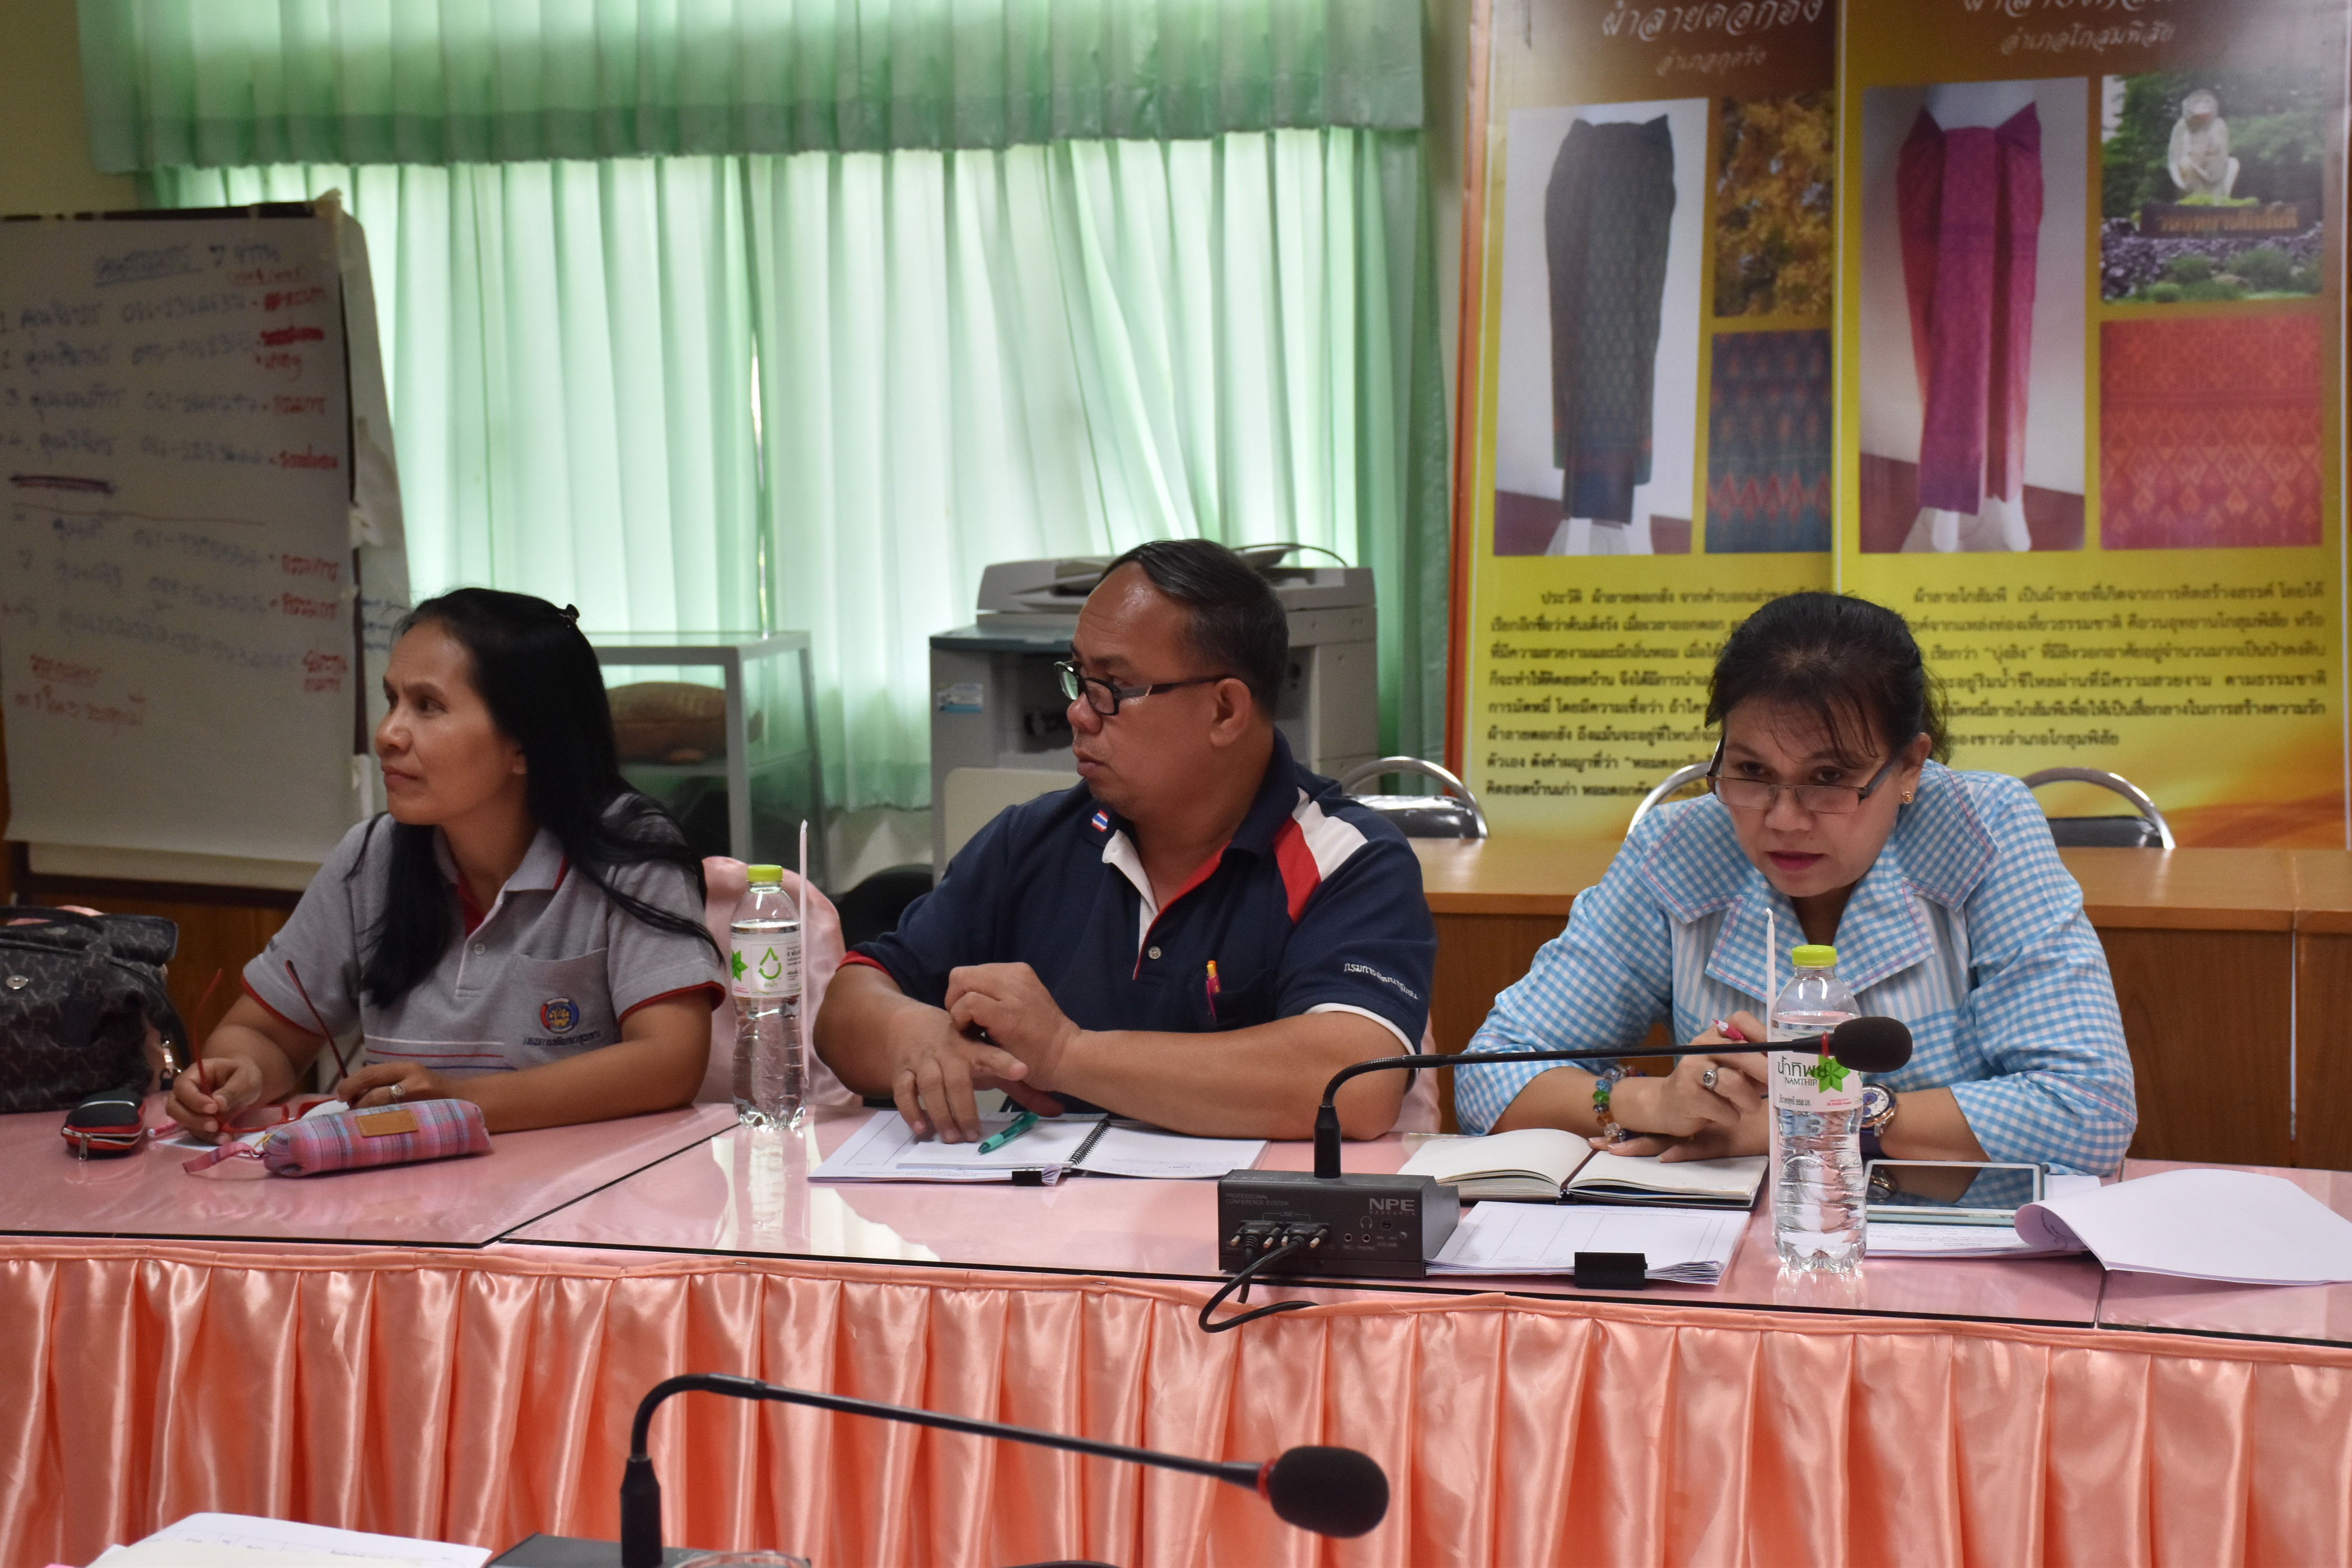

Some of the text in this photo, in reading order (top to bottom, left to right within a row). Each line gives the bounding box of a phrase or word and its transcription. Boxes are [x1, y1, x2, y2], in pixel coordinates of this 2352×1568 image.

[1777, 1055, 1832, 1077] น้ำทิพย์
[1785, 1077, 1817, 1086] NAMTHIP
[1369, 1198, 1415, 1212] NPE
